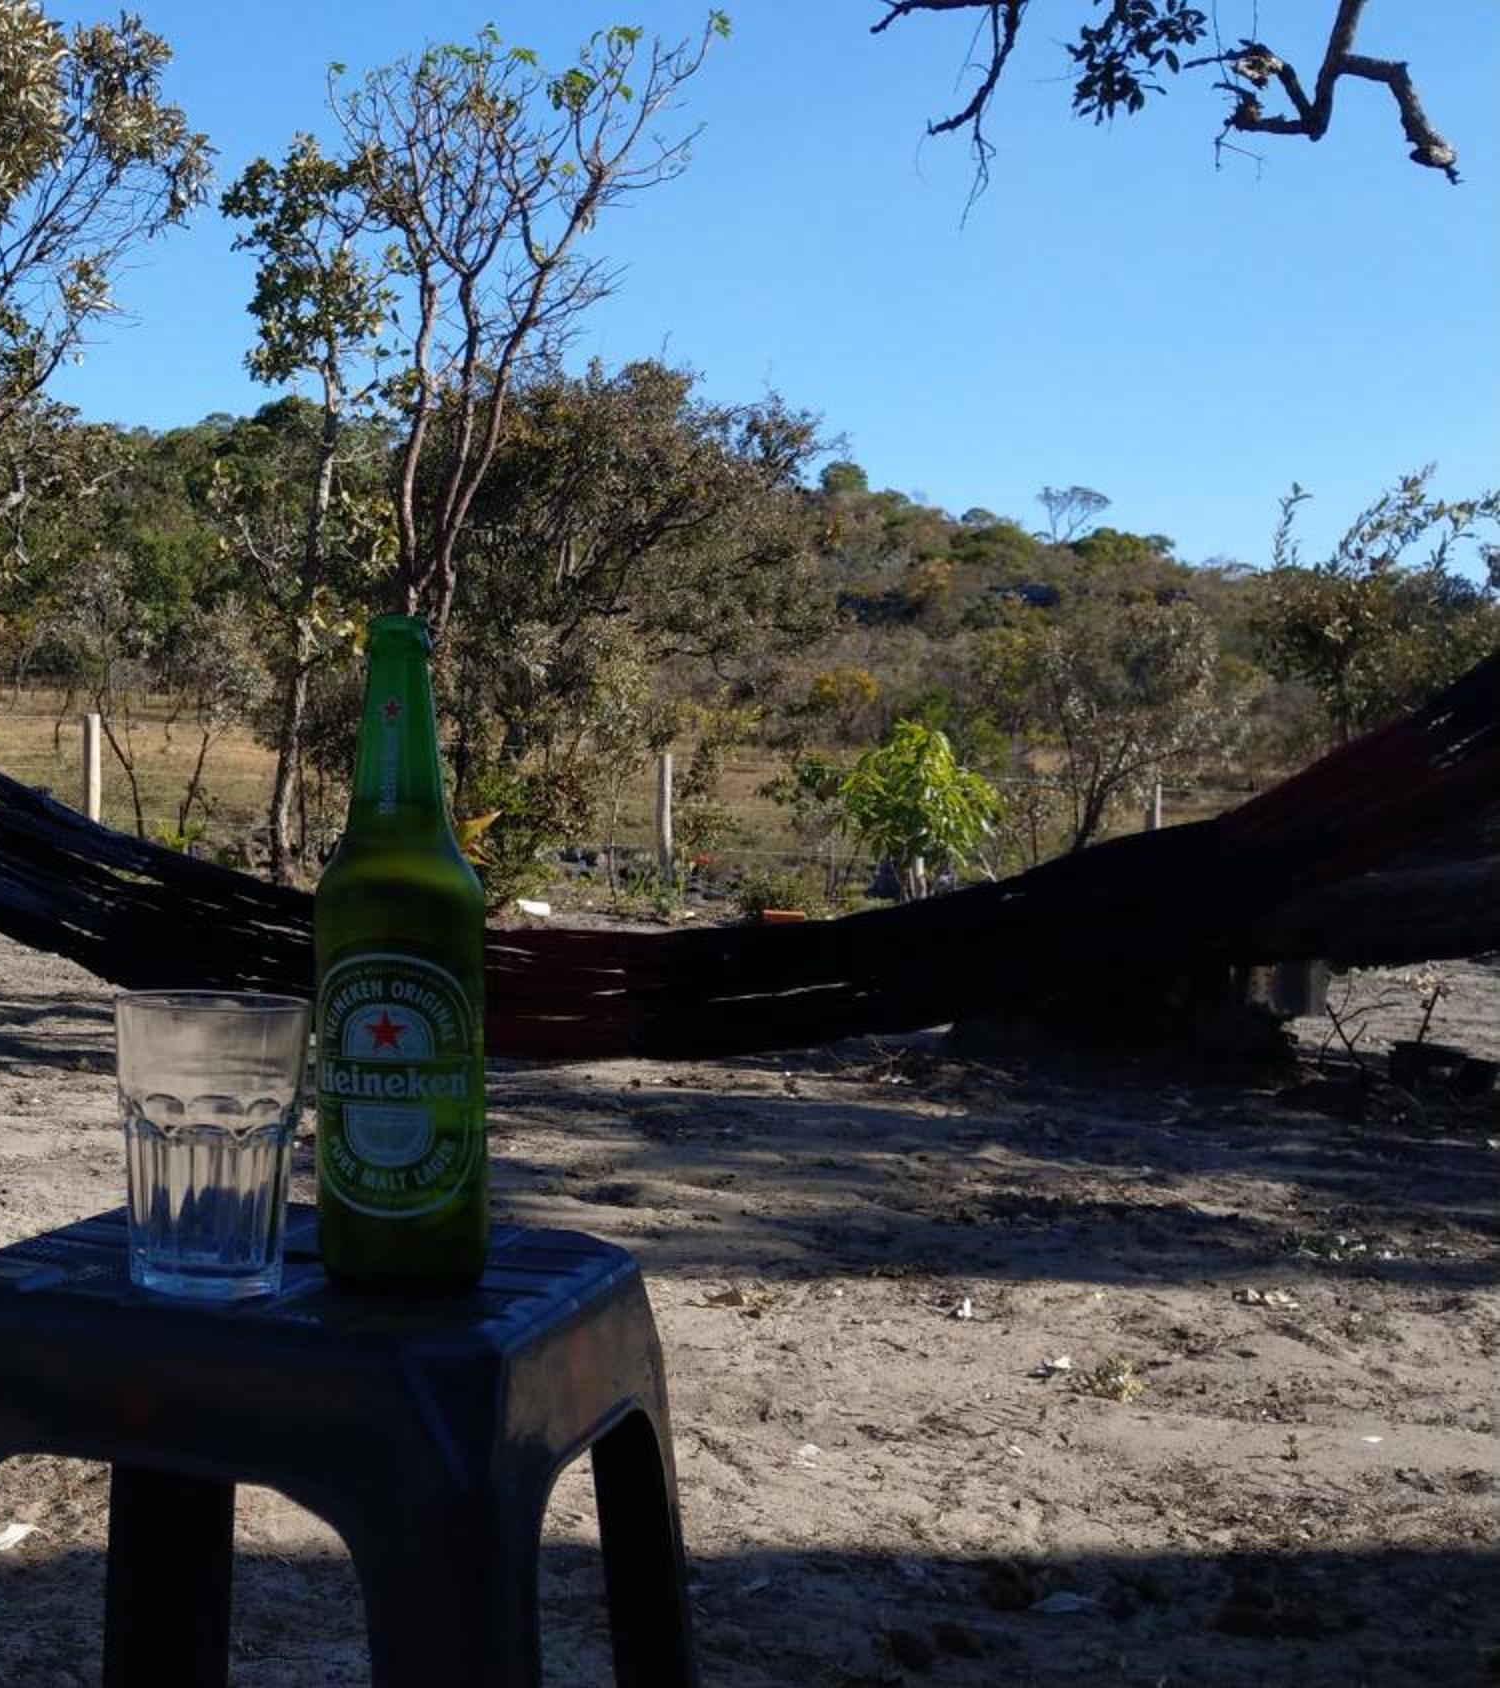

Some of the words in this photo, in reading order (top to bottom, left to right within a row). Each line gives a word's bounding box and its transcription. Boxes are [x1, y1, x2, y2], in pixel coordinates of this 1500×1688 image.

[325, 980, 383, 1040] HEINEKEN
[322, 1062, 467, 1098] Heineken
[361, 1168, 407, 1192] MALT
